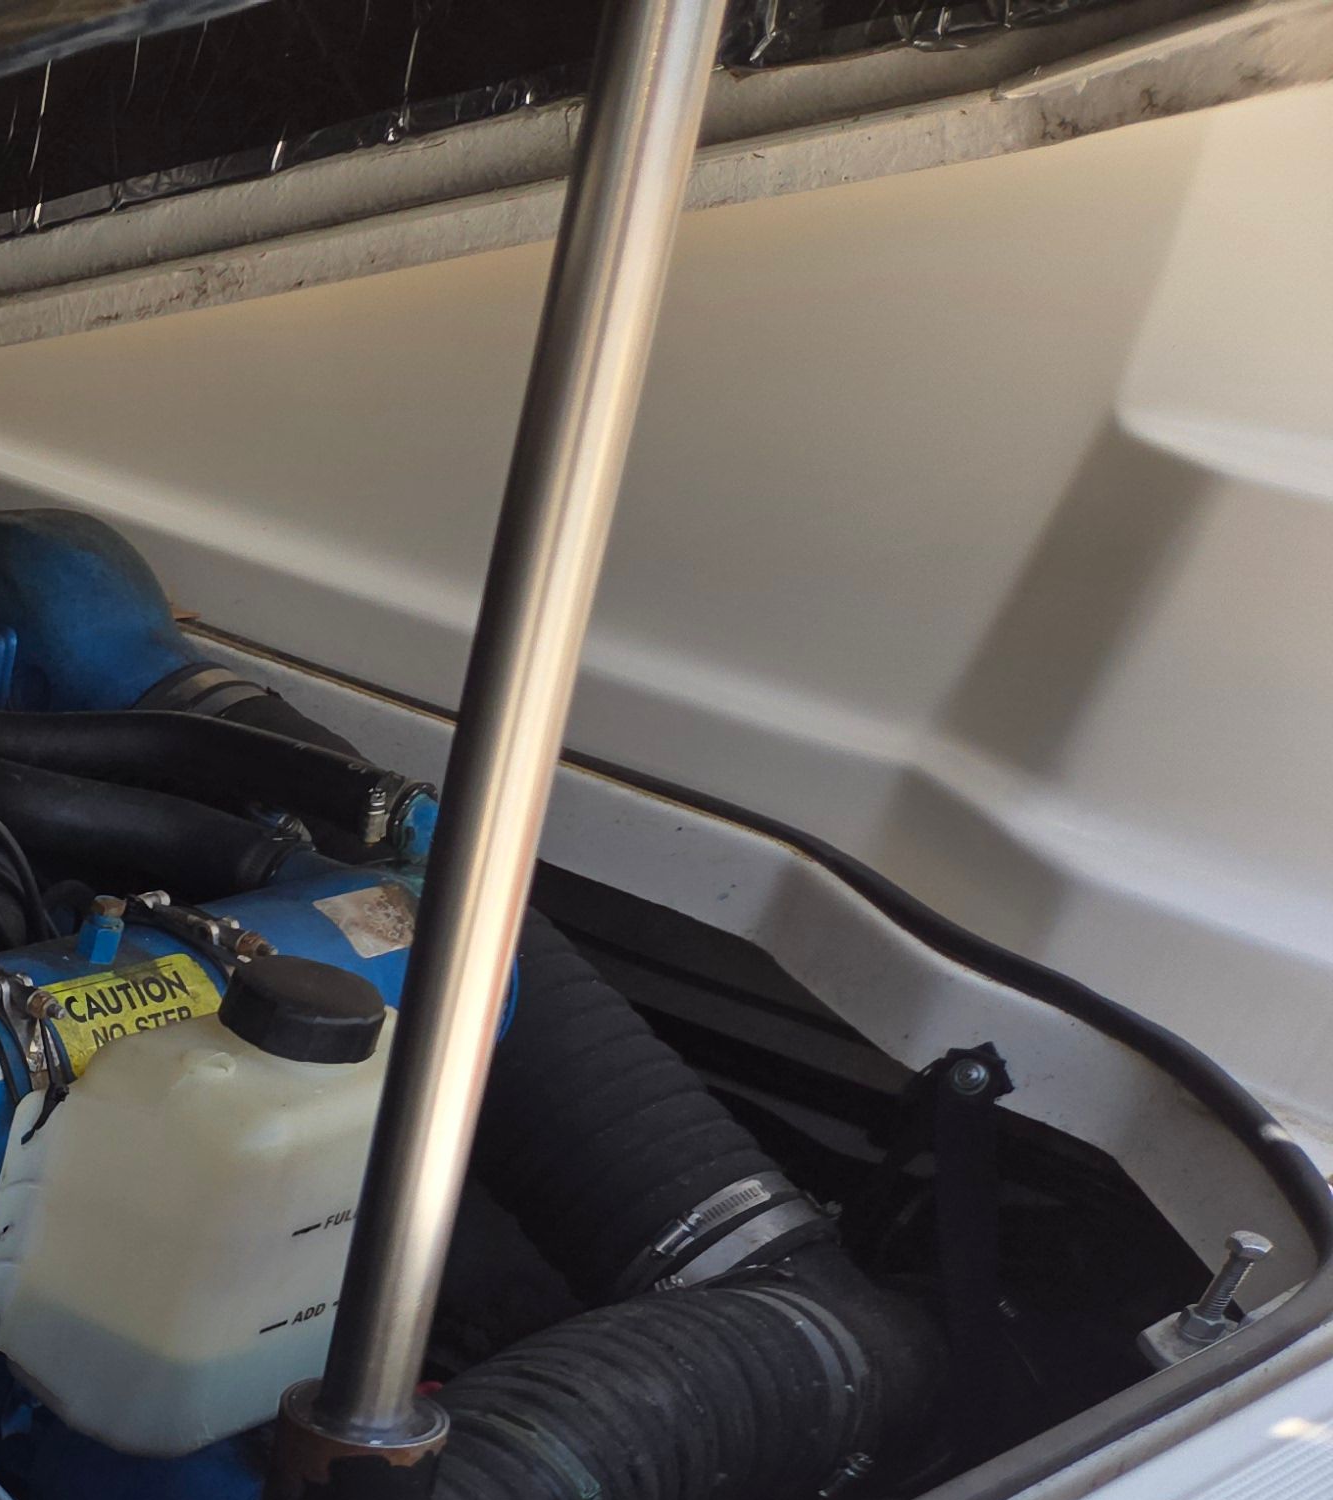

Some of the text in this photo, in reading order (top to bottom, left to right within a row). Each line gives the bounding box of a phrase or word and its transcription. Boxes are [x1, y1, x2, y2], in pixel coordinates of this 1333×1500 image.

[64, 969, 191, 1023] CAUTION
[91, 1022, 128, 1049] NO
[324, 1209, 357, 1230] FUL
[291, 1303, 326, 1326] ADD
